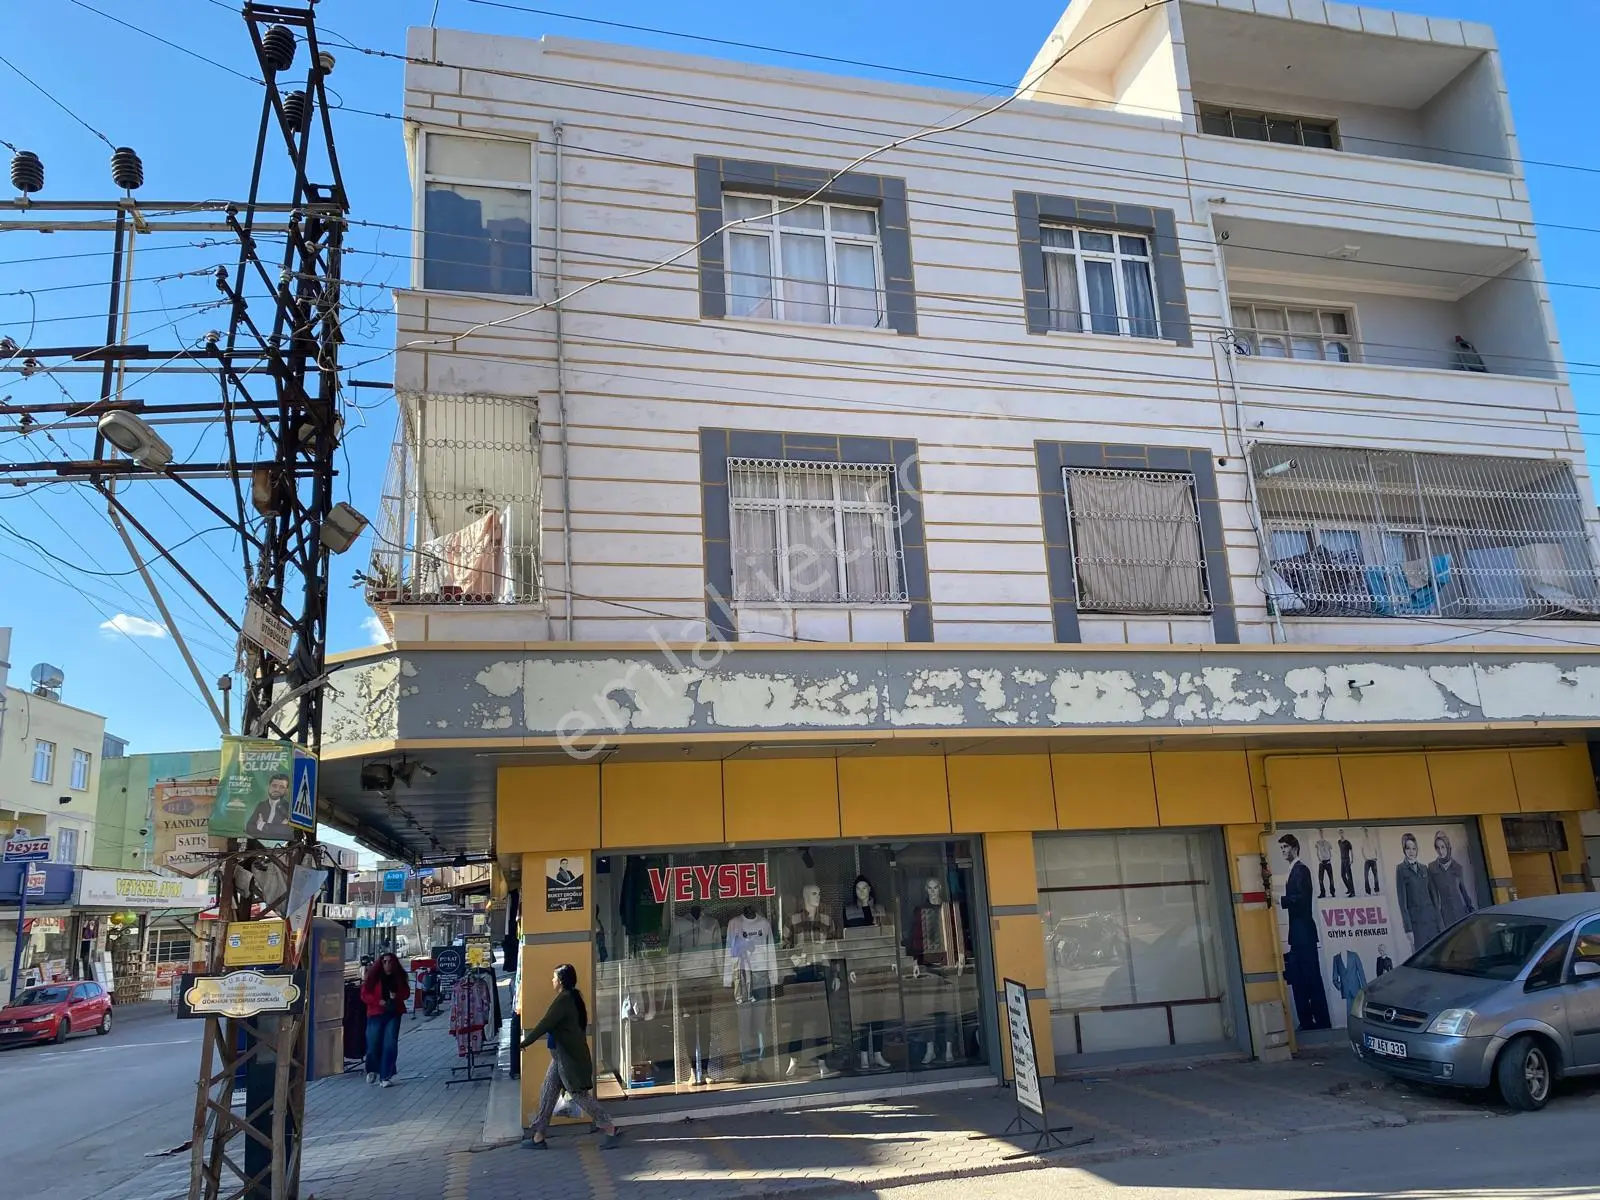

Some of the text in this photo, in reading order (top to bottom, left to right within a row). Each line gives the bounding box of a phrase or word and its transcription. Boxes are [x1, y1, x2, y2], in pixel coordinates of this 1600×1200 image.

[243, 761, 280, 771] OLUR
[6, 842, 49, 853] beyza
[116, 878, 158, 897] VEYSEL
[648, 863, 776, 904] VEYSEL
[1321, 907, 1388, 928] VEYSEL
[1355, 927, 1388, 937] AYAKKABI
[1390, 1042, 1406, 1057] 339
